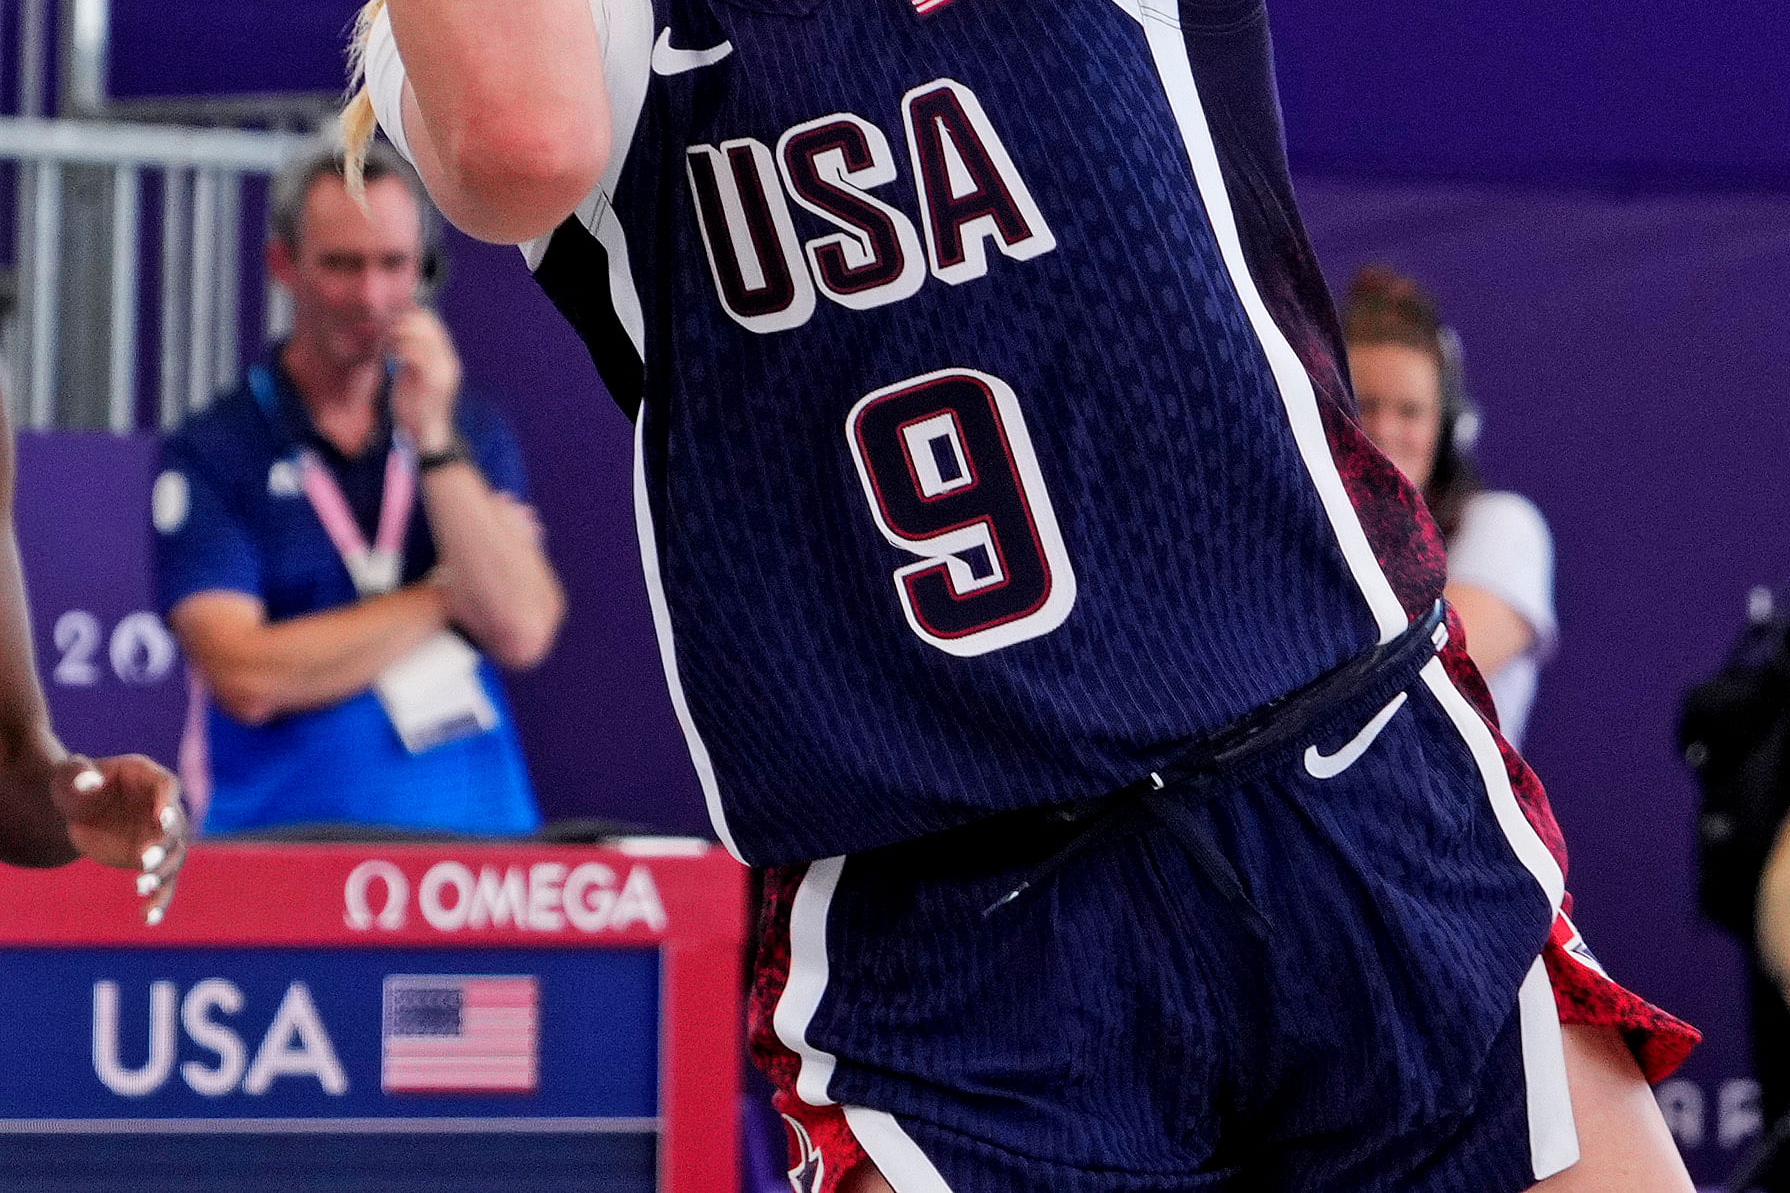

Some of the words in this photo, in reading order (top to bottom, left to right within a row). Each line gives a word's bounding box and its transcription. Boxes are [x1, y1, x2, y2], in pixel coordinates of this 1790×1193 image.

[687, 78, 1057, 333] USA
[846, 367, 1077, 658] 9
[419, 862, 667, 933] OMEGA
[92, 979, 348, 1097] USA
